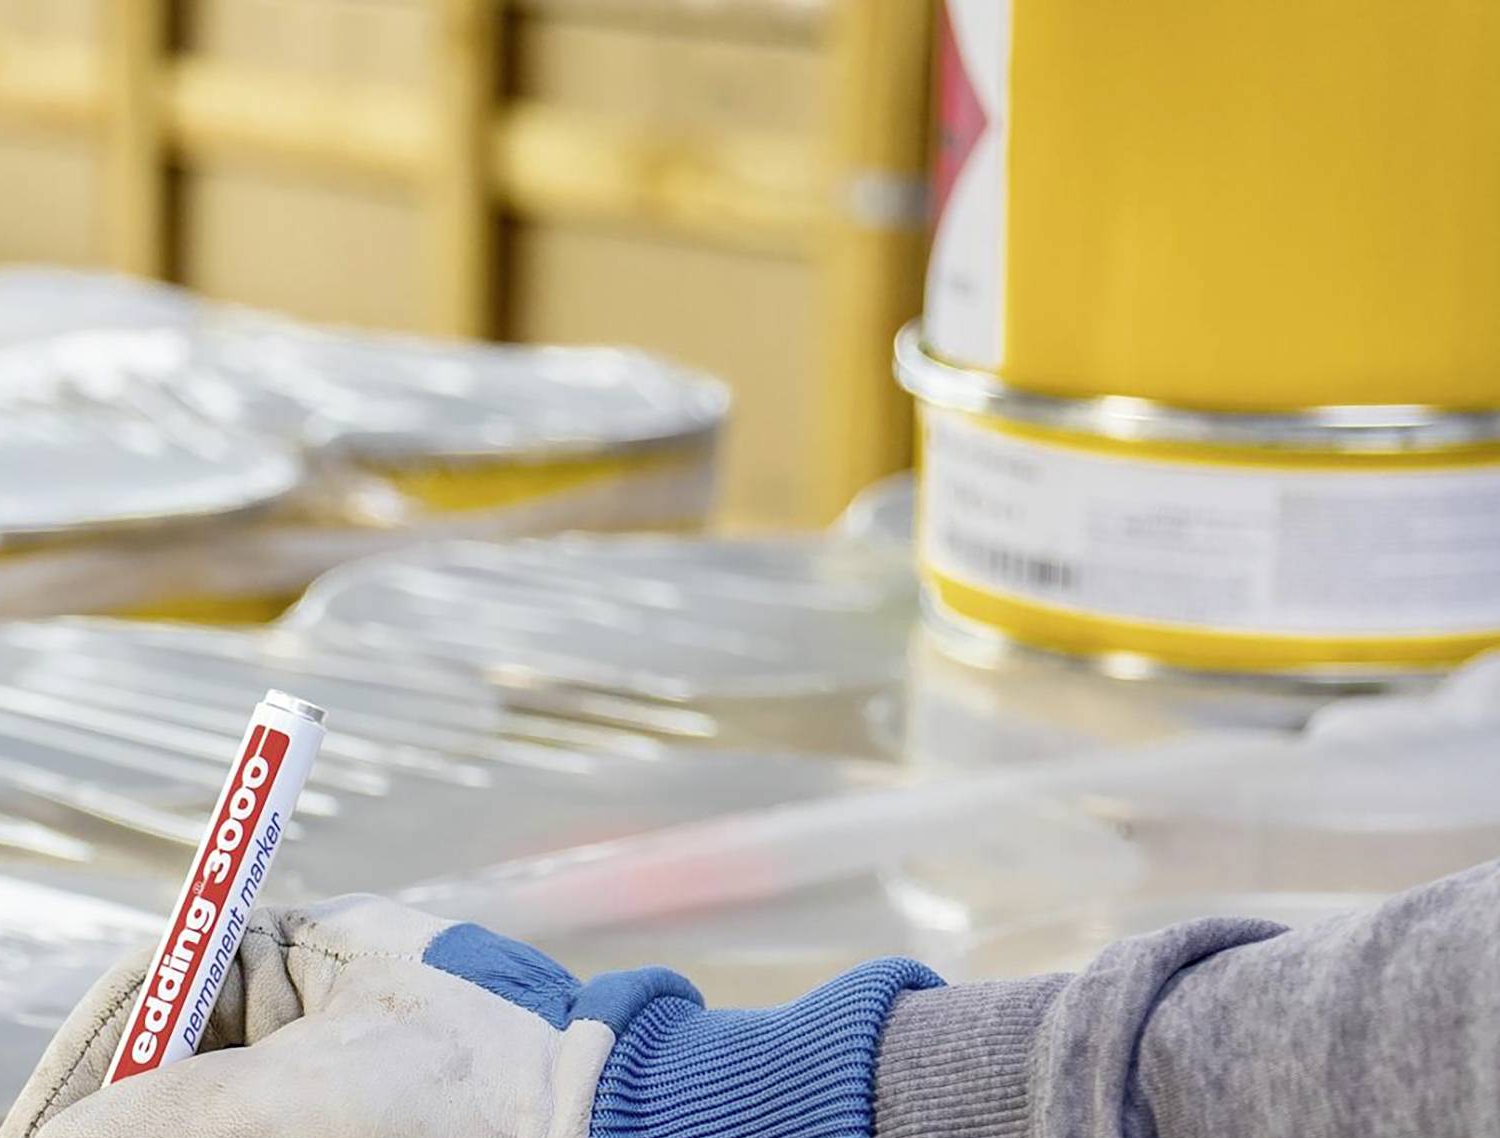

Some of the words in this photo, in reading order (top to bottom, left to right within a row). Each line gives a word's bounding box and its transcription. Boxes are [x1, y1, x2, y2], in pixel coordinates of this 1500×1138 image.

[203, 754, 270, 885] 3000
[182, 906, 245, 1052] permanent
[239, 811, 282, 909] marker
